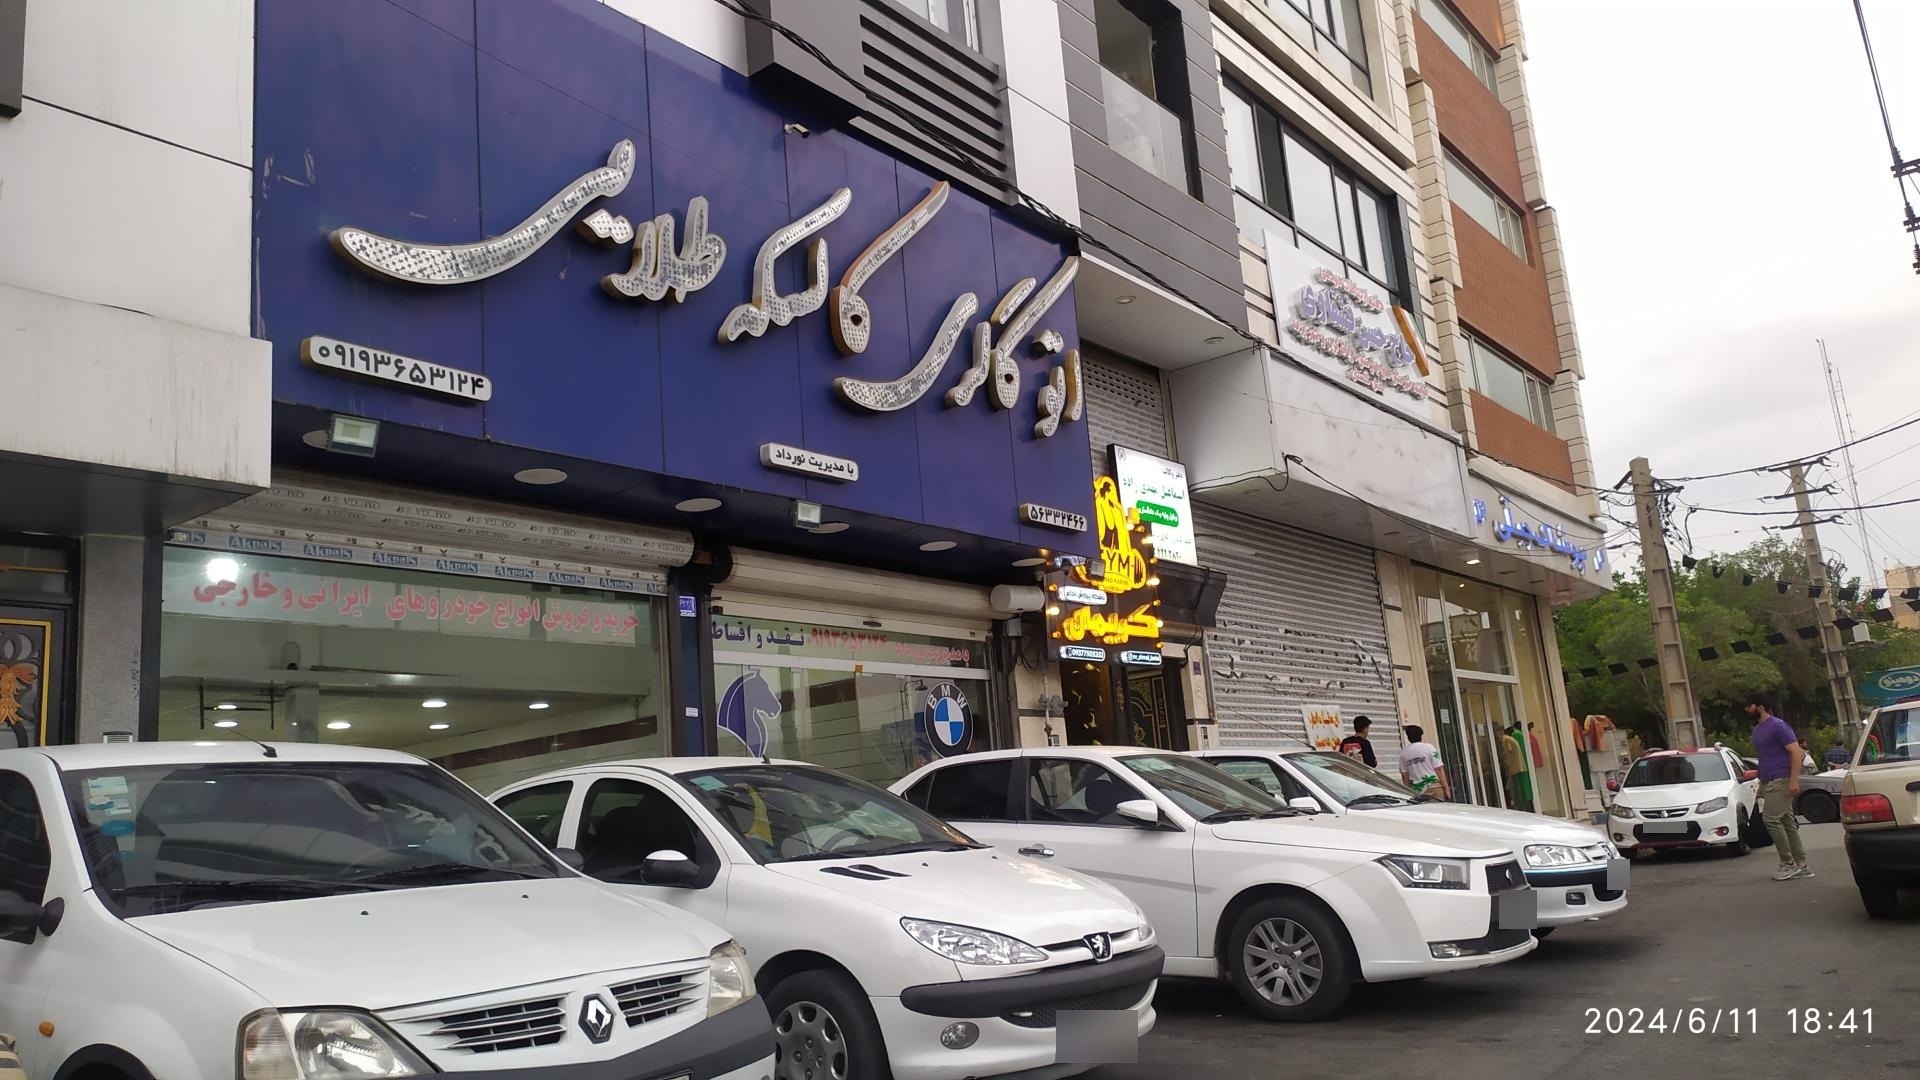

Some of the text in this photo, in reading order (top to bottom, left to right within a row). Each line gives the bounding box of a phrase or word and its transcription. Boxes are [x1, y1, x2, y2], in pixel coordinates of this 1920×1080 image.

[330, 138, 728, 303] طلایی
[831, 255, 1079, 412] گالری
[317, 343, 486, 397] ۰۹۱۹۳۶۵۳۱۲۴
[775, 448, 855, 475] با مدیریت نورداد
[1028, 505, 1085, 530] ۵۶۳۳۲۴۶۶
[193, 570, 278, 607] خارجی
[281, 585, 294, 609] و
[298, 577, 371, 618] ایرانی
[492, 595, 541, 629] انواع
[542, 600, 592, 632] فروش
[592, 615, 601, 633] و
[602, 605, 640, 637] خرید
[1062, 603, 1160, 645] کریمی
[711, 621, 752, 643] اقساط
[756, 634, 763, 649] و
[766, 626, 805, 647] نقد
